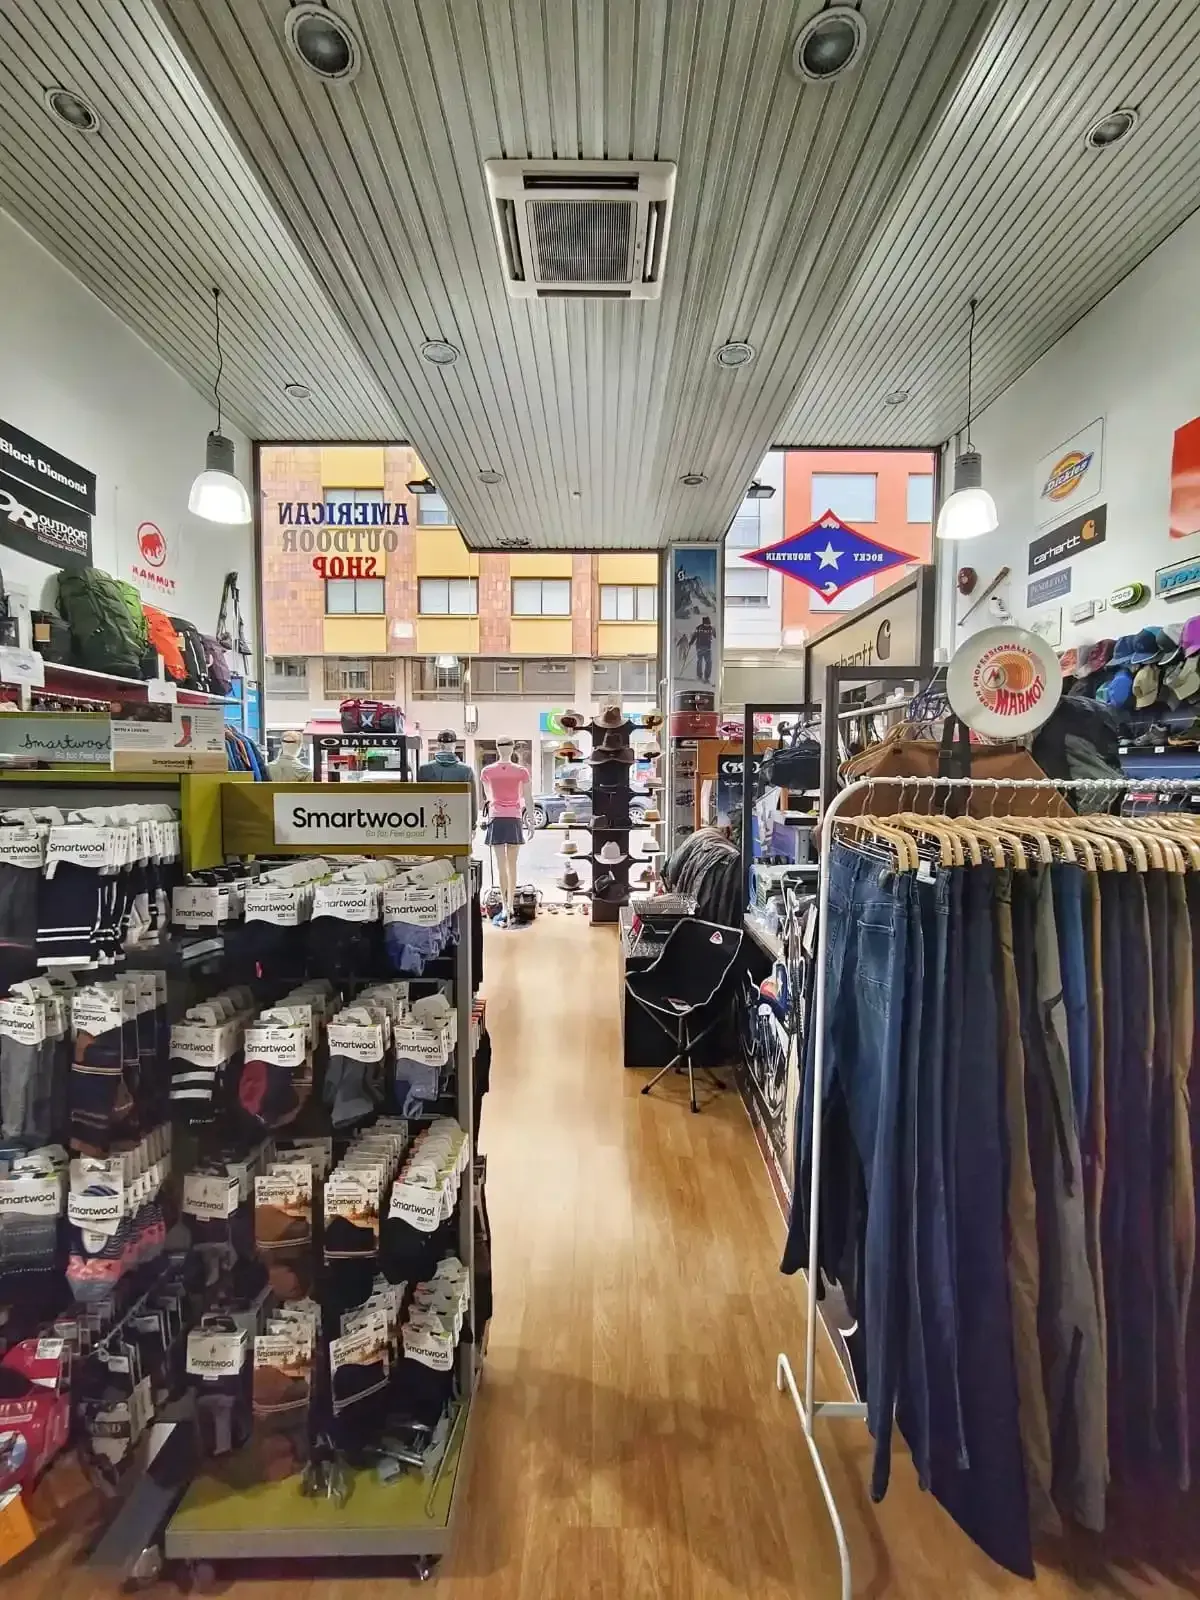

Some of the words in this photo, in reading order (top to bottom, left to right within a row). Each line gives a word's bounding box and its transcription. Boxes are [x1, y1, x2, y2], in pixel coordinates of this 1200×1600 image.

[0, 437, 36, 469] Black
[37, 459, 88, 496] Diamond
[1046, 459, 1090, 491] Dickies
[38, 514, 88, 540] OUTDOOR
[37, 521, 88, 550] RESEARCH
[1033, 534, 1081, 566] carhartt
[132, 565, 176, 589] MAMMUT
[1110, 589, 1132, 603] crocs
[973, 643, 1033, 688] PROFESSIONALLY
[994, 675, 1045, 717] MARMOT
[18, 733, 112, 750] Smartwool
[341, 738, 400, 746] OAKLEY
[292, 807, 425, 829] Smartwool
[389, 830, 405, 838] Feel
[50, 842, 105, 853] Smartwool
[247, 903, 296, 913] Smartwool
[315, 899, 367, 909] Smartwool
[385, 903, 437, 915] Smartwool
[175, 908, 214, 918] Smartwool
[172, 1040, 214, 1053] Smartwool
[247, 1043, 296, 1053] Smartwool
[330, 1040, 376, 1050] Smartwool
[396, 1042, 441, 1054] Smartwool
[69, 1204, 118, 1216] Smartwool
[186, 1199, 224, 1210] Smartwool
[392, 1198, 435, 1217] Smartwool
[405, 1342, 449, 1359] Smartwool
[191, 1358, 235, 1369] Smartwool
